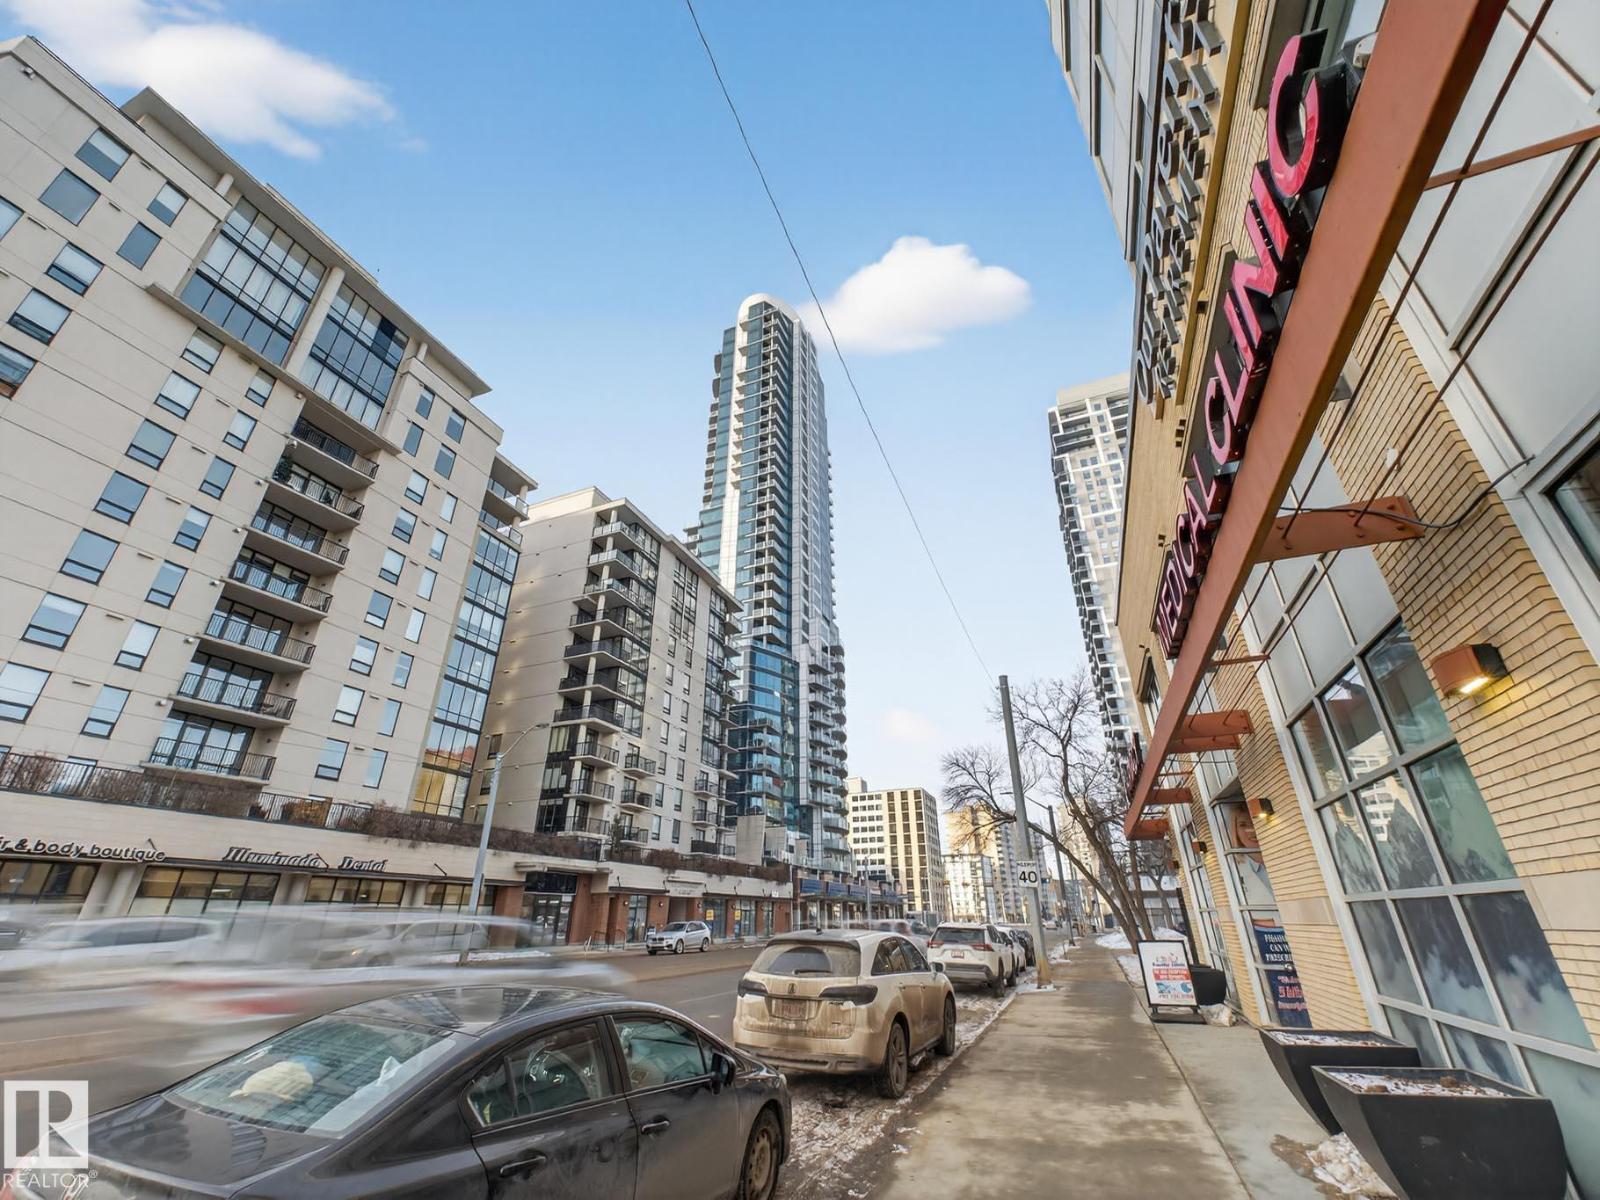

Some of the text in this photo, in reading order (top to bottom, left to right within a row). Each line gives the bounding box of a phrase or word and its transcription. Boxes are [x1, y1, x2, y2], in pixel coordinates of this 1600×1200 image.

[1156, 29, 1330, 660] MEDICAL CLINIC
[15, 838, 29, 851] &
[33, 839, 84, 858] body
[89, 843, 166, 861] boutique
[338, 856, 388, 872] Dental
[1019, 870, 1038, 883] 40
